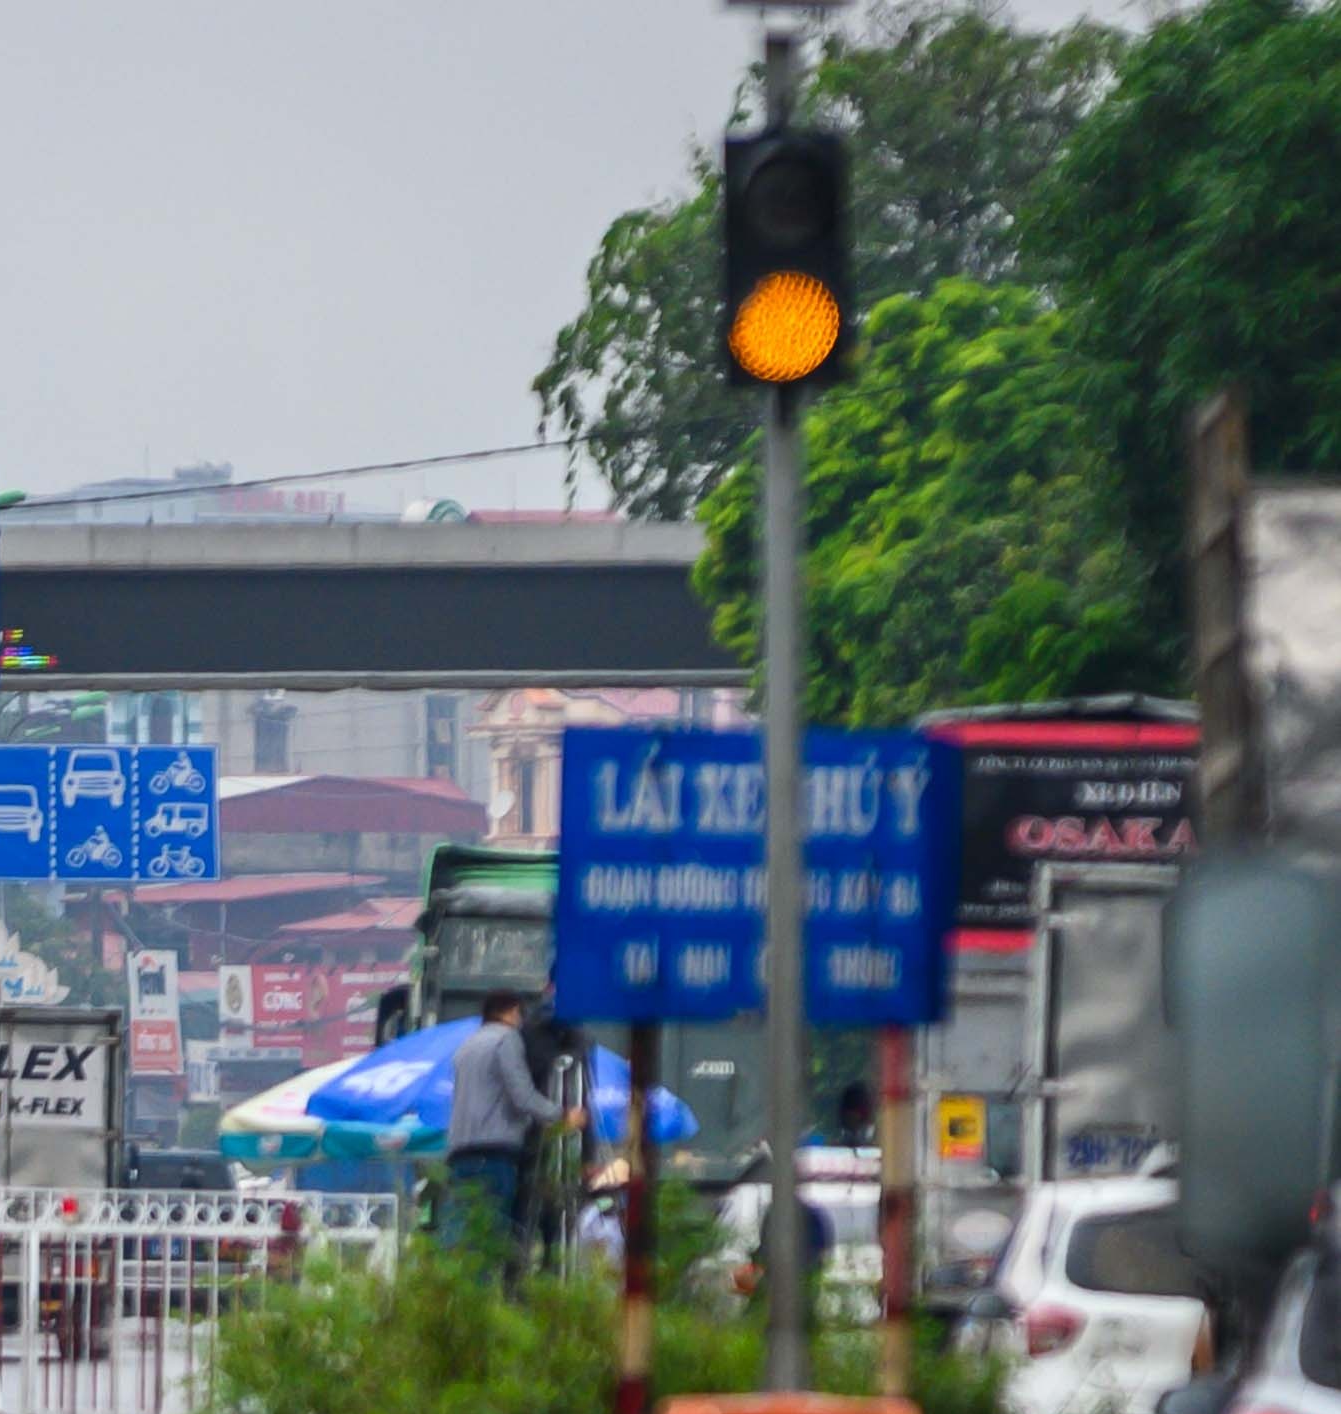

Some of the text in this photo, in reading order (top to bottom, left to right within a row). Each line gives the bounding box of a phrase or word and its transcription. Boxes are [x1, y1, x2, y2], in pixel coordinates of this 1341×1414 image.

[806, 749, 884, 836] HÚ
[1007, 814, 1199, 857] OSAKA
[8, 1096, 87, 1117] K-FLEX
